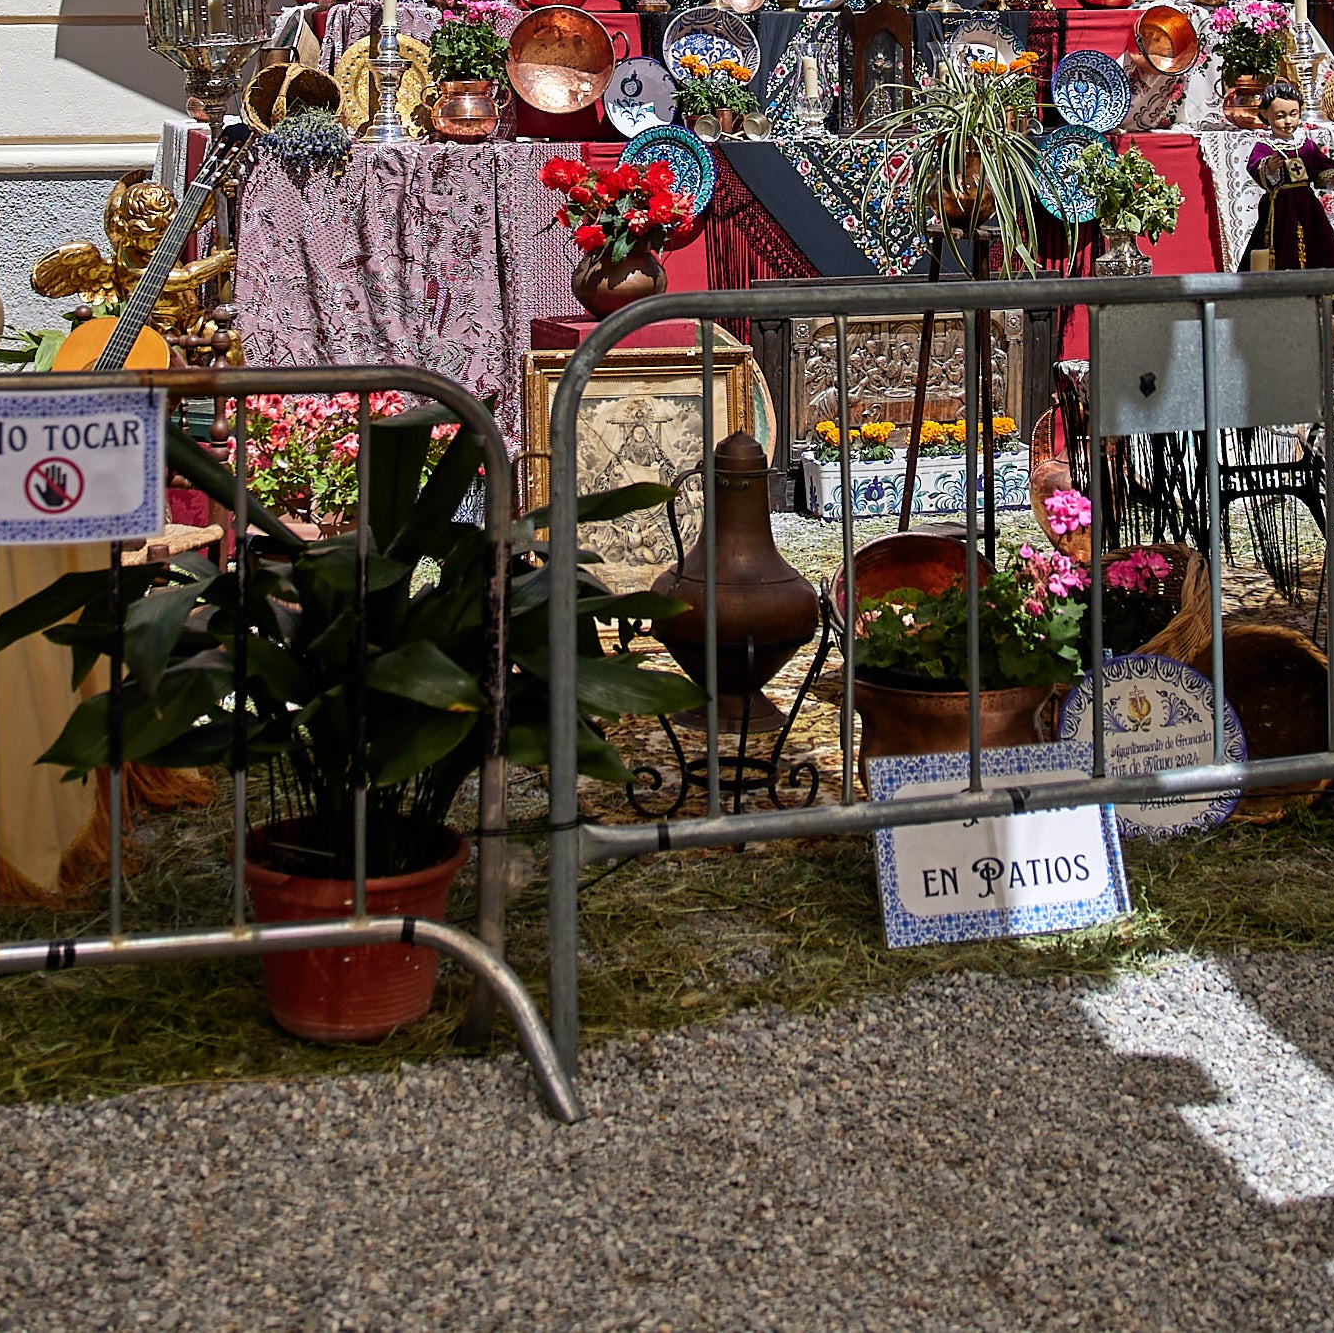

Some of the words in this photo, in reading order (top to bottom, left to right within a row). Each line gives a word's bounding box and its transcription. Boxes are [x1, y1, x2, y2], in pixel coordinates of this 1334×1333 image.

[43, 419, 141, 451] TOCAR
[1110, 738, 1164, 763] Ayuntamiento
[1165, 736, 1175, 750] de
[1175, 729, 1212, 750] Granada
[1129, 758, 1141, 775] de
[1175, 751, 1201, 769] 2024
[922, 866, 960, 898] EN
[971, 853, 1091, 898] PATIOS
